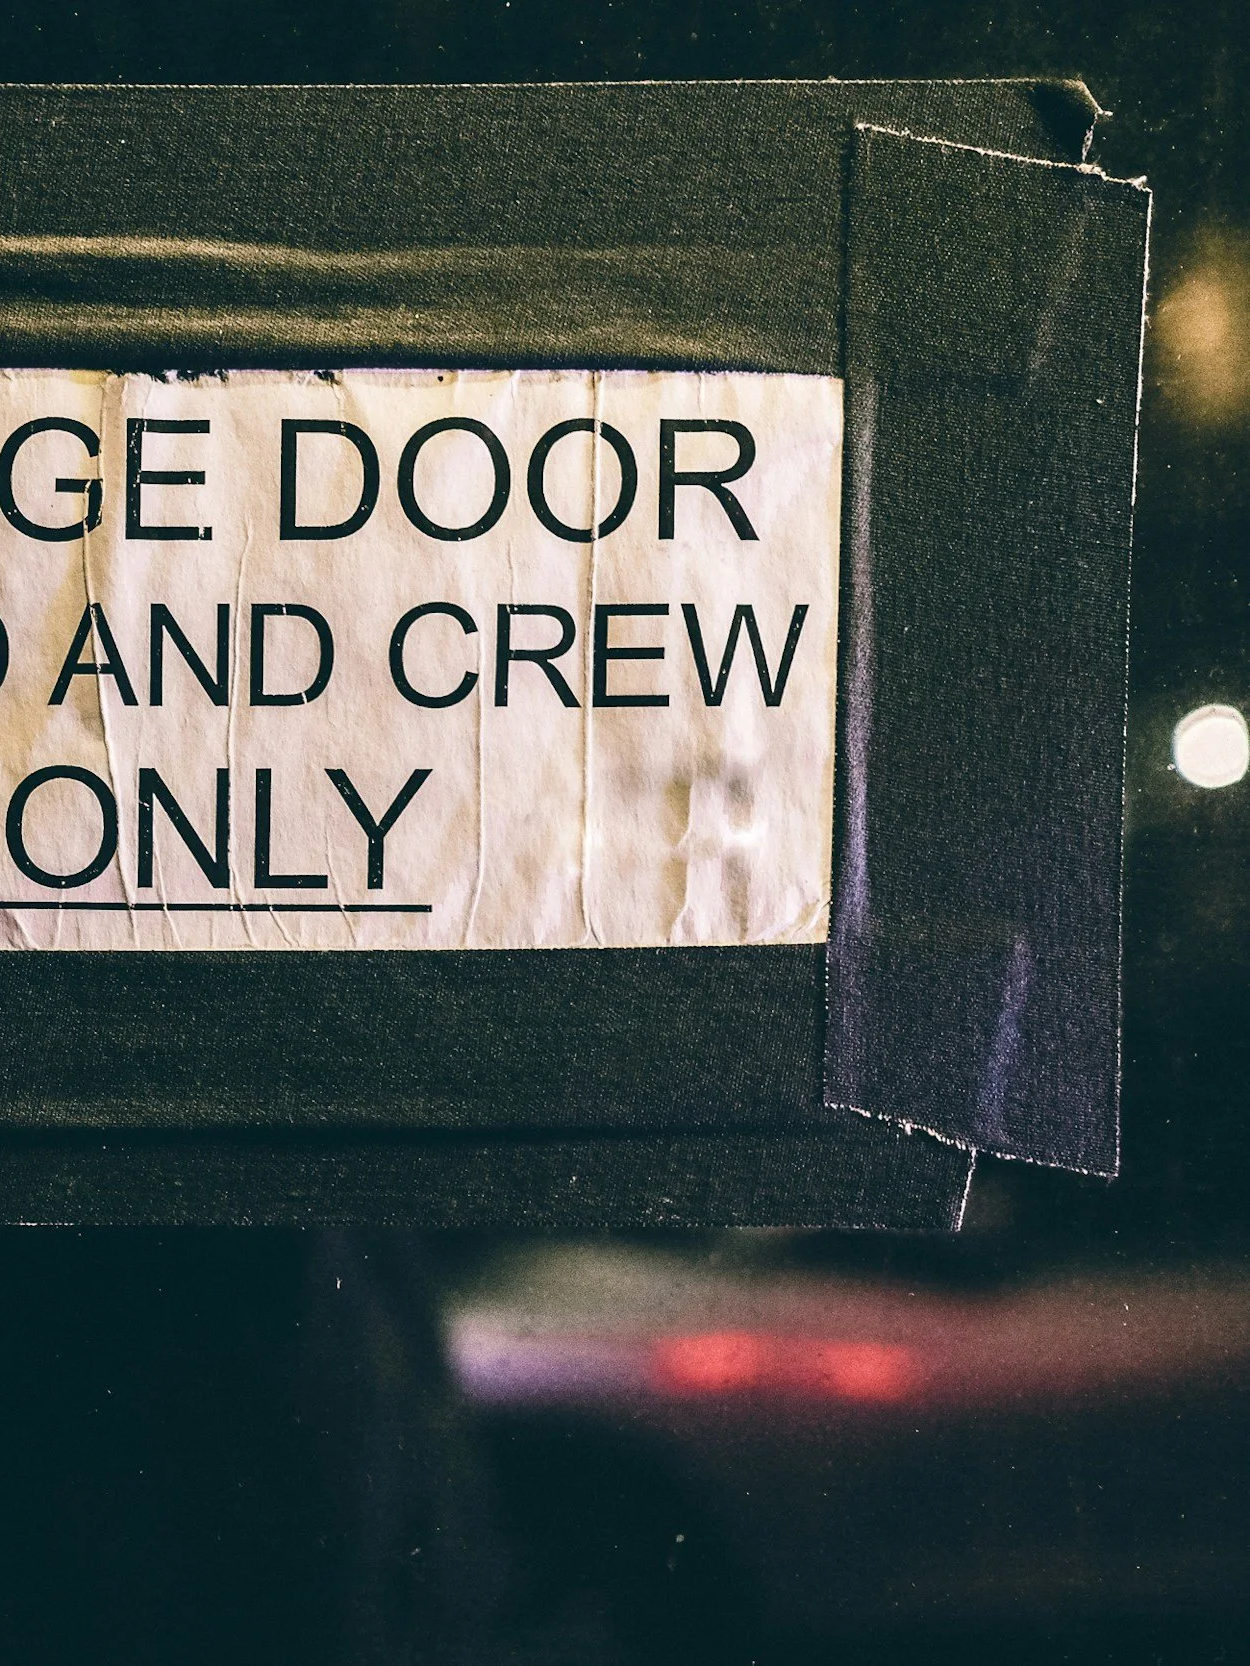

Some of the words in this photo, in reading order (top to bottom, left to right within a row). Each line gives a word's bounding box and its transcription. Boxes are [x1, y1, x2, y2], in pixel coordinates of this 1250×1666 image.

[280, 417, 760, 543] DOOR
[48, 600, 335, 708] AND
[389, 602, 810, 708] CREW
[6, 765, 433, 890] ONLY
